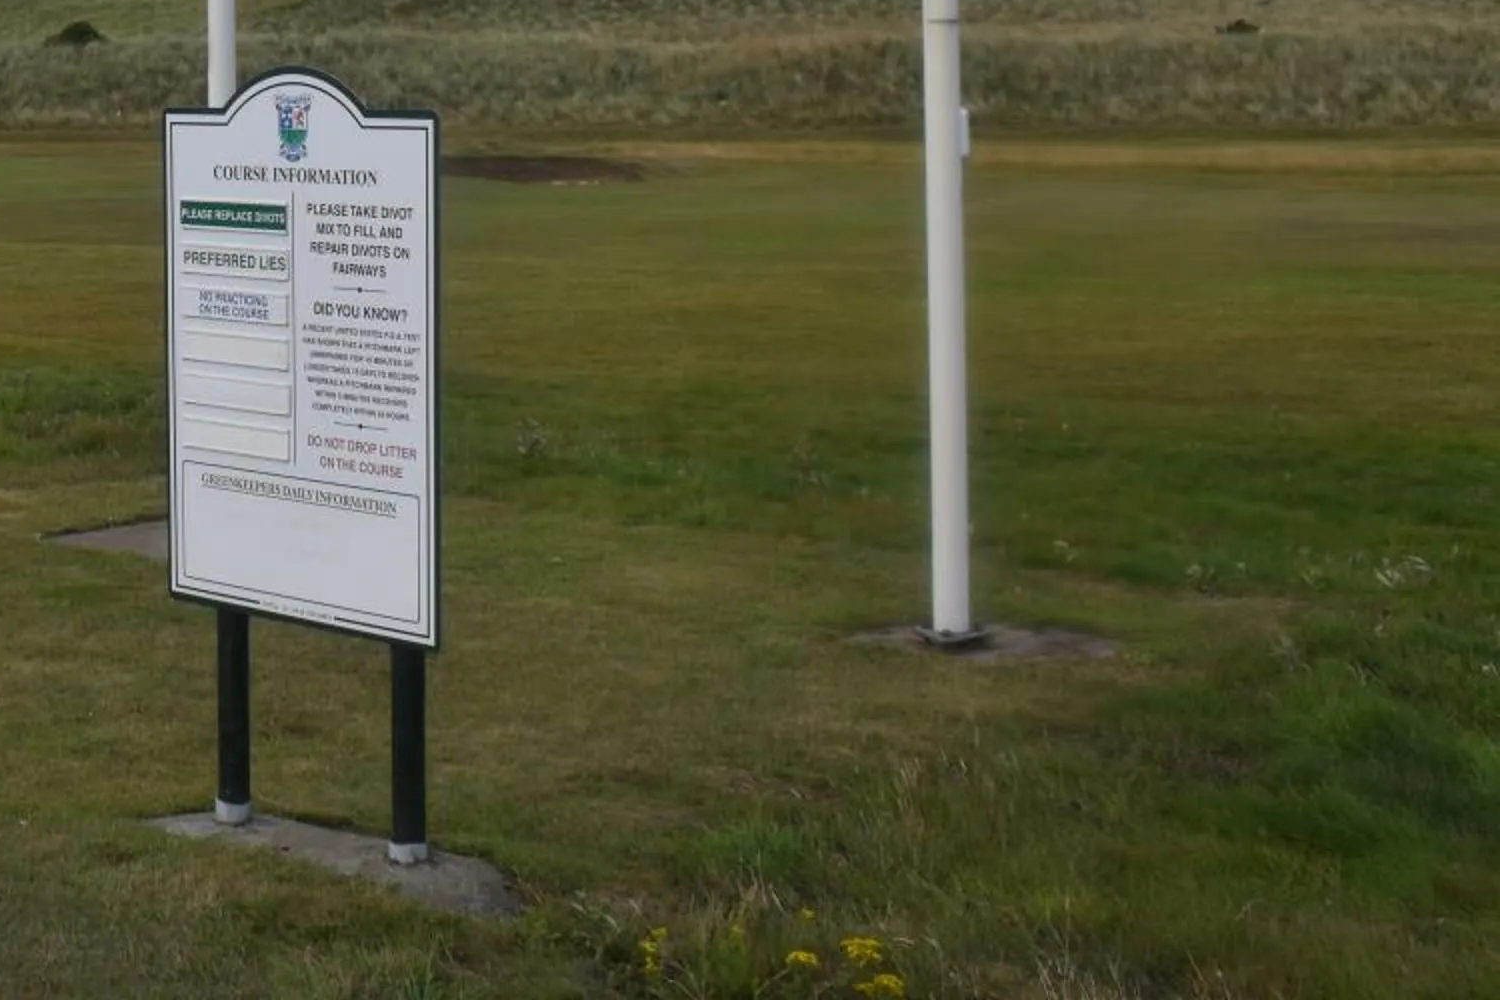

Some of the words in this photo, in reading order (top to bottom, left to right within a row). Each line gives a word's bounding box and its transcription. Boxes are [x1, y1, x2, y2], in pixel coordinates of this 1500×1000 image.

[213, 165, 269, 182] COURSE
[273, 168, 378, 187] INFORMATION
[181, 207, 212, 220] PLEASE
[214, 209, 252, 222] REPLACE
[254, 211, 285, 224] DIVOTS
[307, 203, 348, 217] PLEASE
[349, 205, 378, 219] TAKE
[381, 206, 414, 220] DIVOT
[316, 222, 335, 236] MIX
[336, 223, 351, 237] TO
[353, 224, 377, 239] FILL
[379, 226, 403, 240] AND
[183, 250, 255, 269] PREFERRED
[258, 255, 287, 272] LIES
[309, 241, 349, 256] REPAIR
[351, 243, 391, 259] DIVOTS
[393, 245, 411, 261] ON
[332, 261, 388, 279] FAIRWAYS
[199, 289, 213, 302] NO
[199, 303, 213, 314] ON
[213, 304, 230, 316] THE
[231, 306, 270, 320] COURSE
[313, 301, 334, 317] DID
[335, 303, 361, 320] YOU
[363, 305, 408, 324] KNOW?
[308, 434, 322, 447] DO
[324, 436, 345, 450] NOT
[347, 439, 377, 455] DROP
[379, 443, 417, 461] LITTER
[319, 455, 335, 469] ON
[336, 458, 357, 472] THE
[359, 460, 404, 478] COURSE
[283, 487, 315, 501] DAILY
[315, 489, 397, 514] INFORMATION
